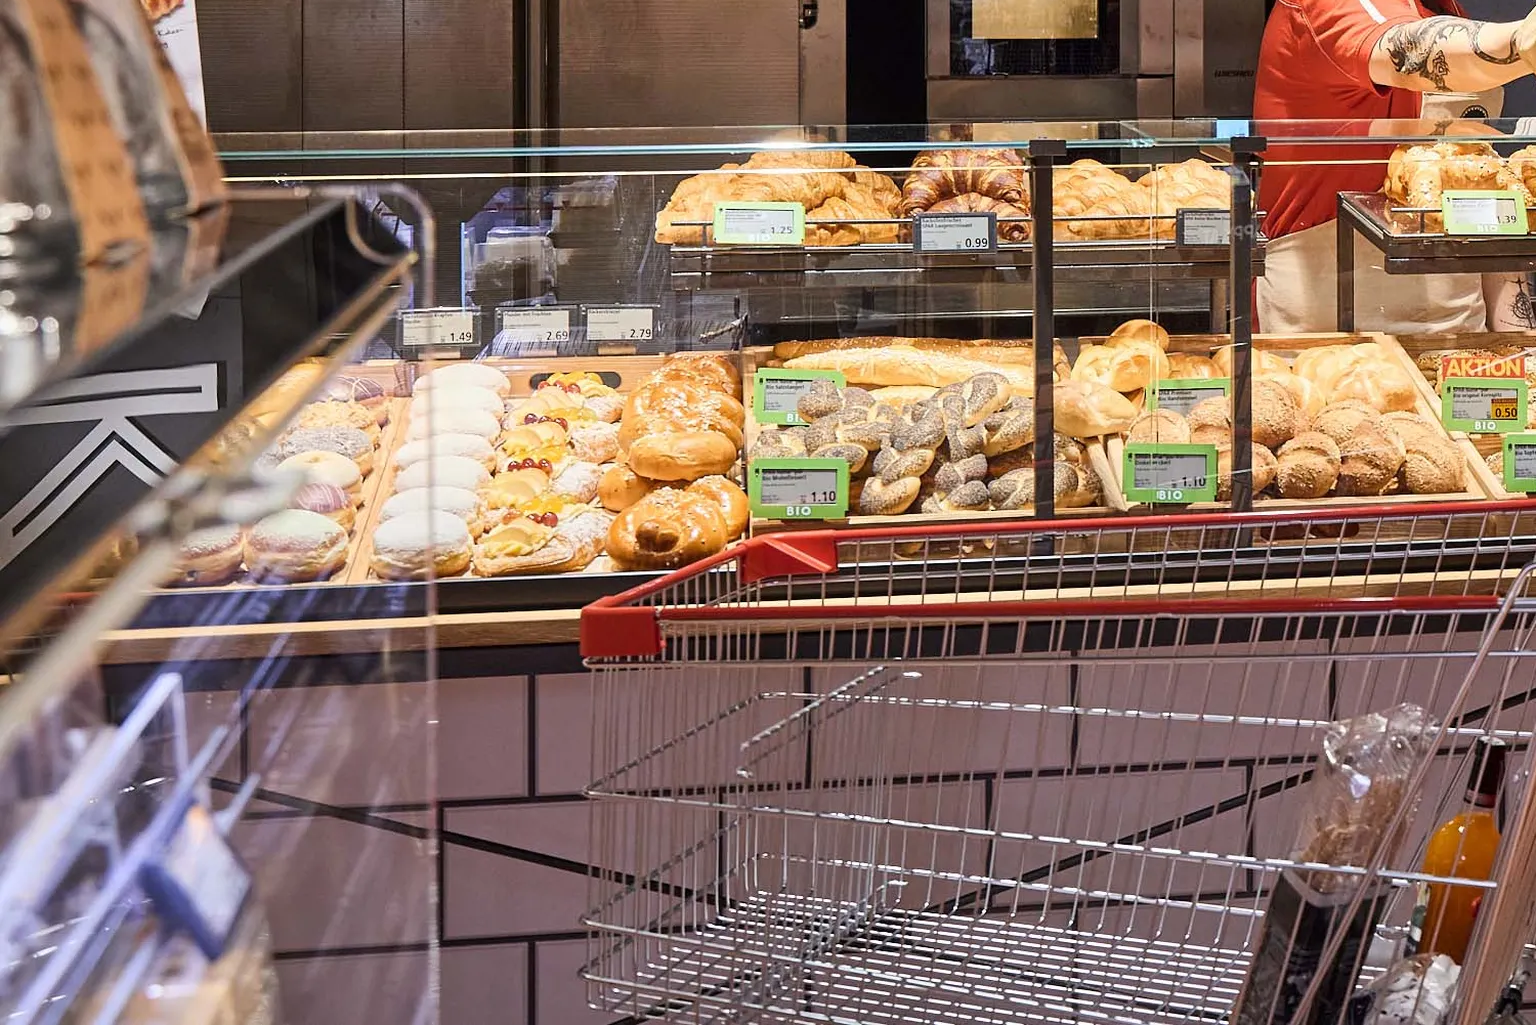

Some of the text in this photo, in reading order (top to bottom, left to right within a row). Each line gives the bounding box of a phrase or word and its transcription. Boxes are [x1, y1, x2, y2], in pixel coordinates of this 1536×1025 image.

[770, 226, 793, 235] 1.25
[965, 237, 988, 248] 0.99
[450, 332, 472, 342] 1.49
[546, 331, 568, 341] 2.69
[630, 328, 652, 338] 2.79
[1446, 358, 1521, 376] AKTION
[1495, 407, 1518, 418] 0.50
[1474, 421, 1496, 430] BIO
[811, 490, 836, 502] 1.10
[1156, 490, 1183, 500] BIO
[786, 506, 812, 516] BIO
